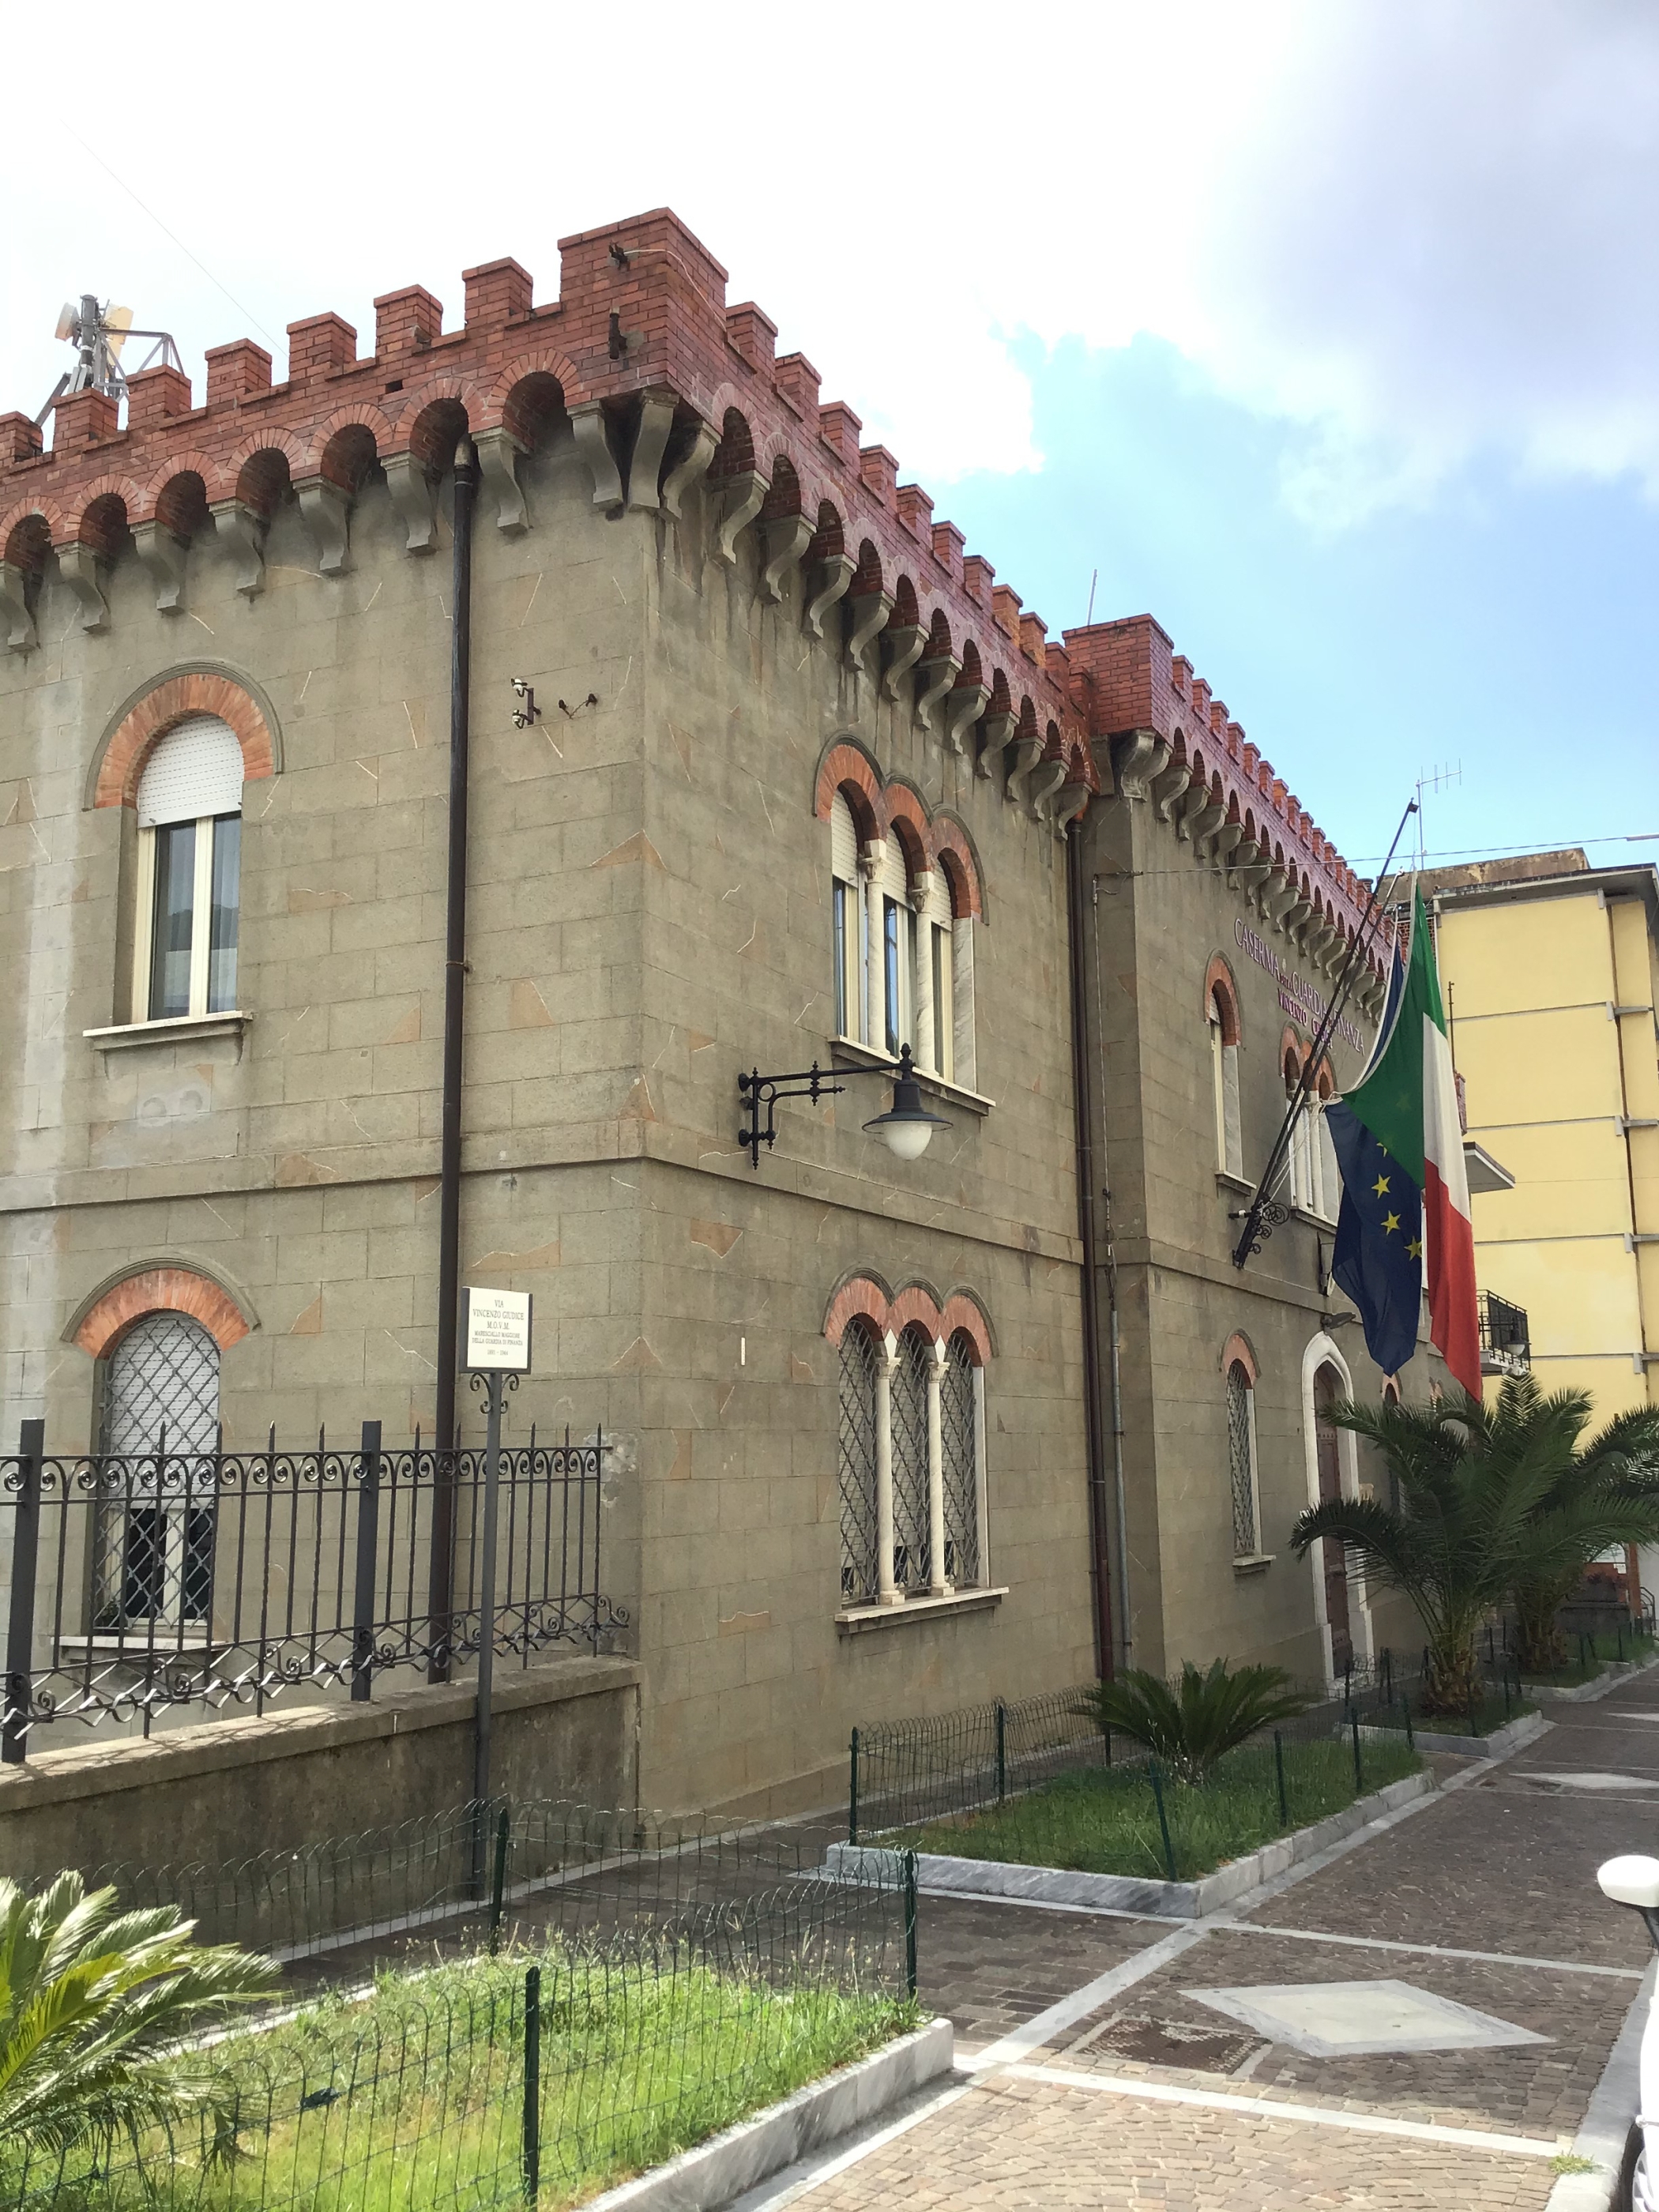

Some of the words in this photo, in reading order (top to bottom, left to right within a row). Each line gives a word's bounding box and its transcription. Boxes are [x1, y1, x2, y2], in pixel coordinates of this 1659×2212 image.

[1234, 918, 1280, 982] CASERMA
[472, 1308, 501, 1319] VINCENZO
[502, 1311, 524, 1320] GIUDICE
